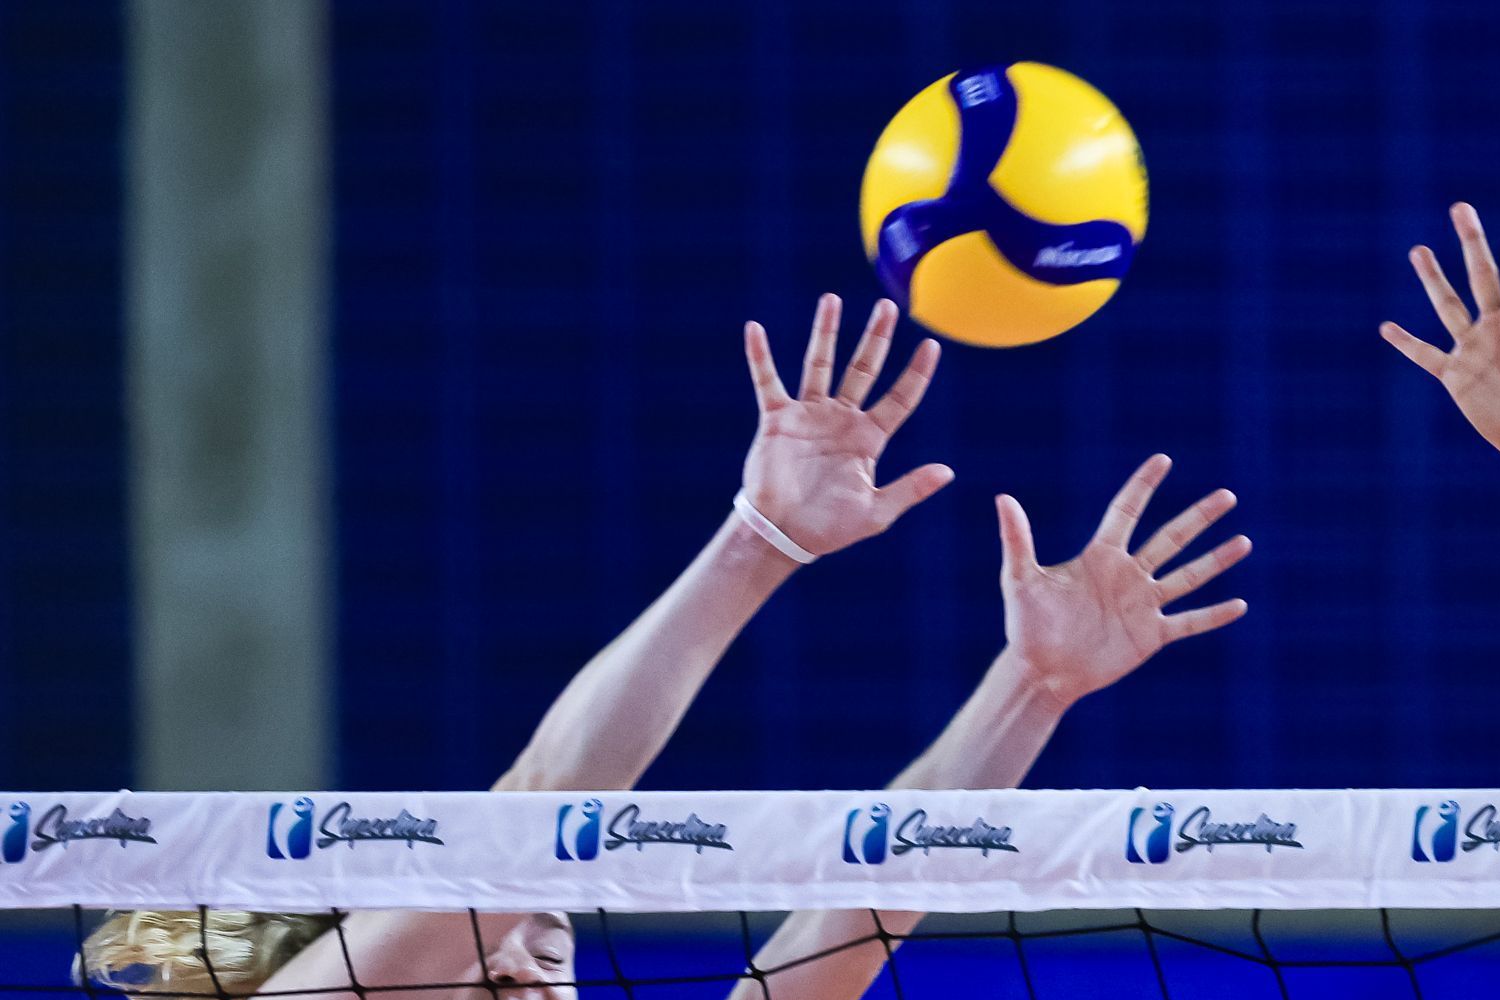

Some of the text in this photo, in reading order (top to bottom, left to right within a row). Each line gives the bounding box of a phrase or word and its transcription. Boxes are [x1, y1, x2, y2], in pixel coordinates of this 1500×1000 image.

[315, 801, 445, 849] Superliga
[603, 803, 735, 855] Superliga
[891, 807, 1020, 857] Superliga
[1175, 805, 1304, 853] Superliga
